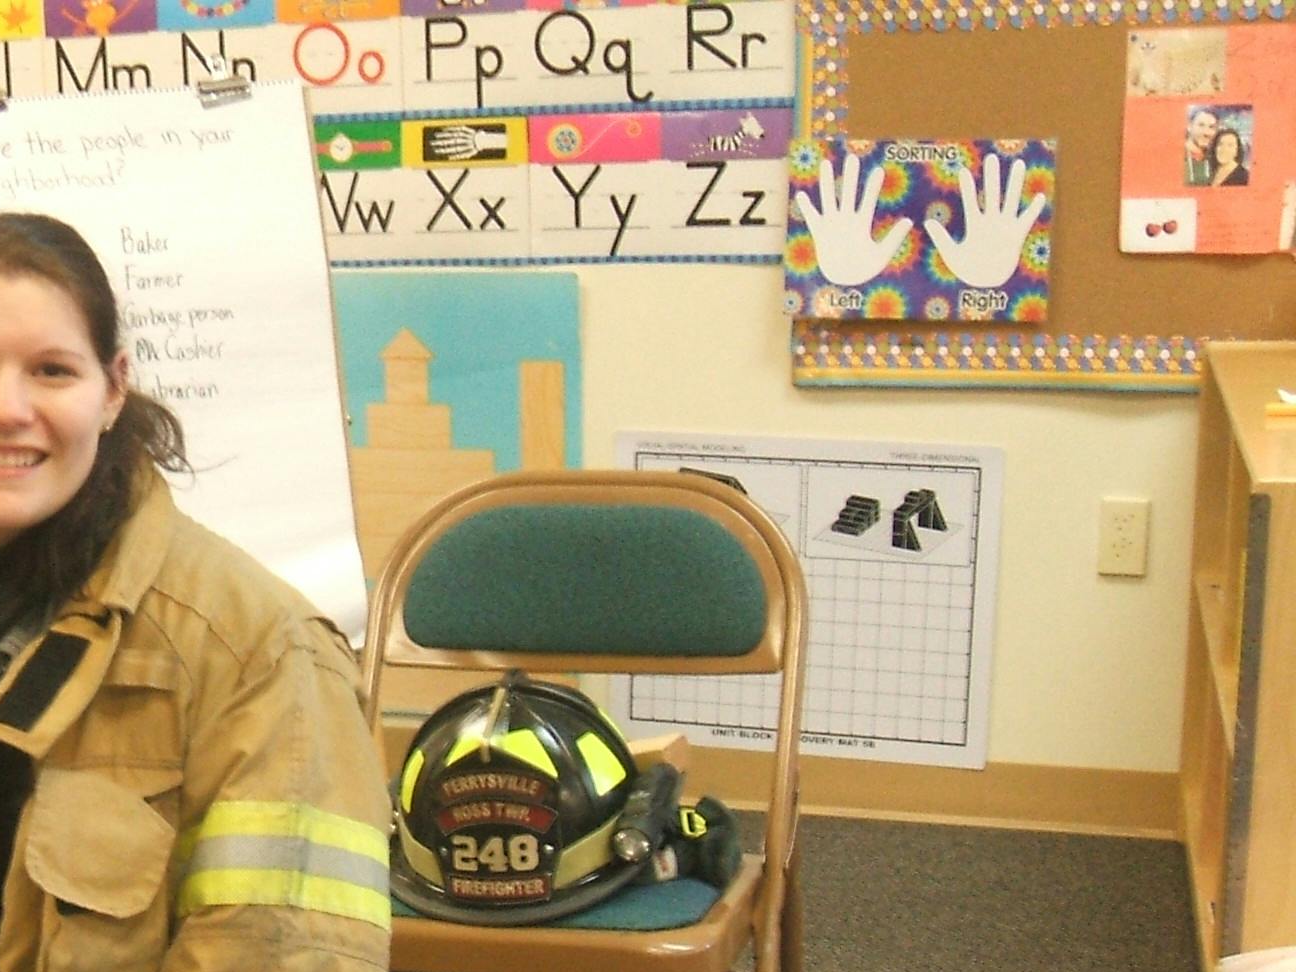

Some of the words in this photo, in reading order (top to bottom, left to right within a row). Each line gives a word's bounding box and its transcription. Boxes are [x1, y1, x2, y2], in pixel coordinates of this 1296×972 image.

[26, 131, 66, 155] the
[80, 125, 145, 161] people
[161, 129, 182, 146] in
[192, 127, 234, 151] your
[886, 144, 959, 163] SORTING
[121, 226, 169, 254] Baker
[125, 264, 184, 290] Farmer
[830, 292, 861, 310] Left
[961, 291, 1007, 312] Right
[189, 308, 235, 328] person
[165, 334, 225, 361] Cashier
[801, 735, 834, 746] OVERY
[451, 834, 539, 872] 248
[452, 878, 545, 896] FIREFIGHTER
